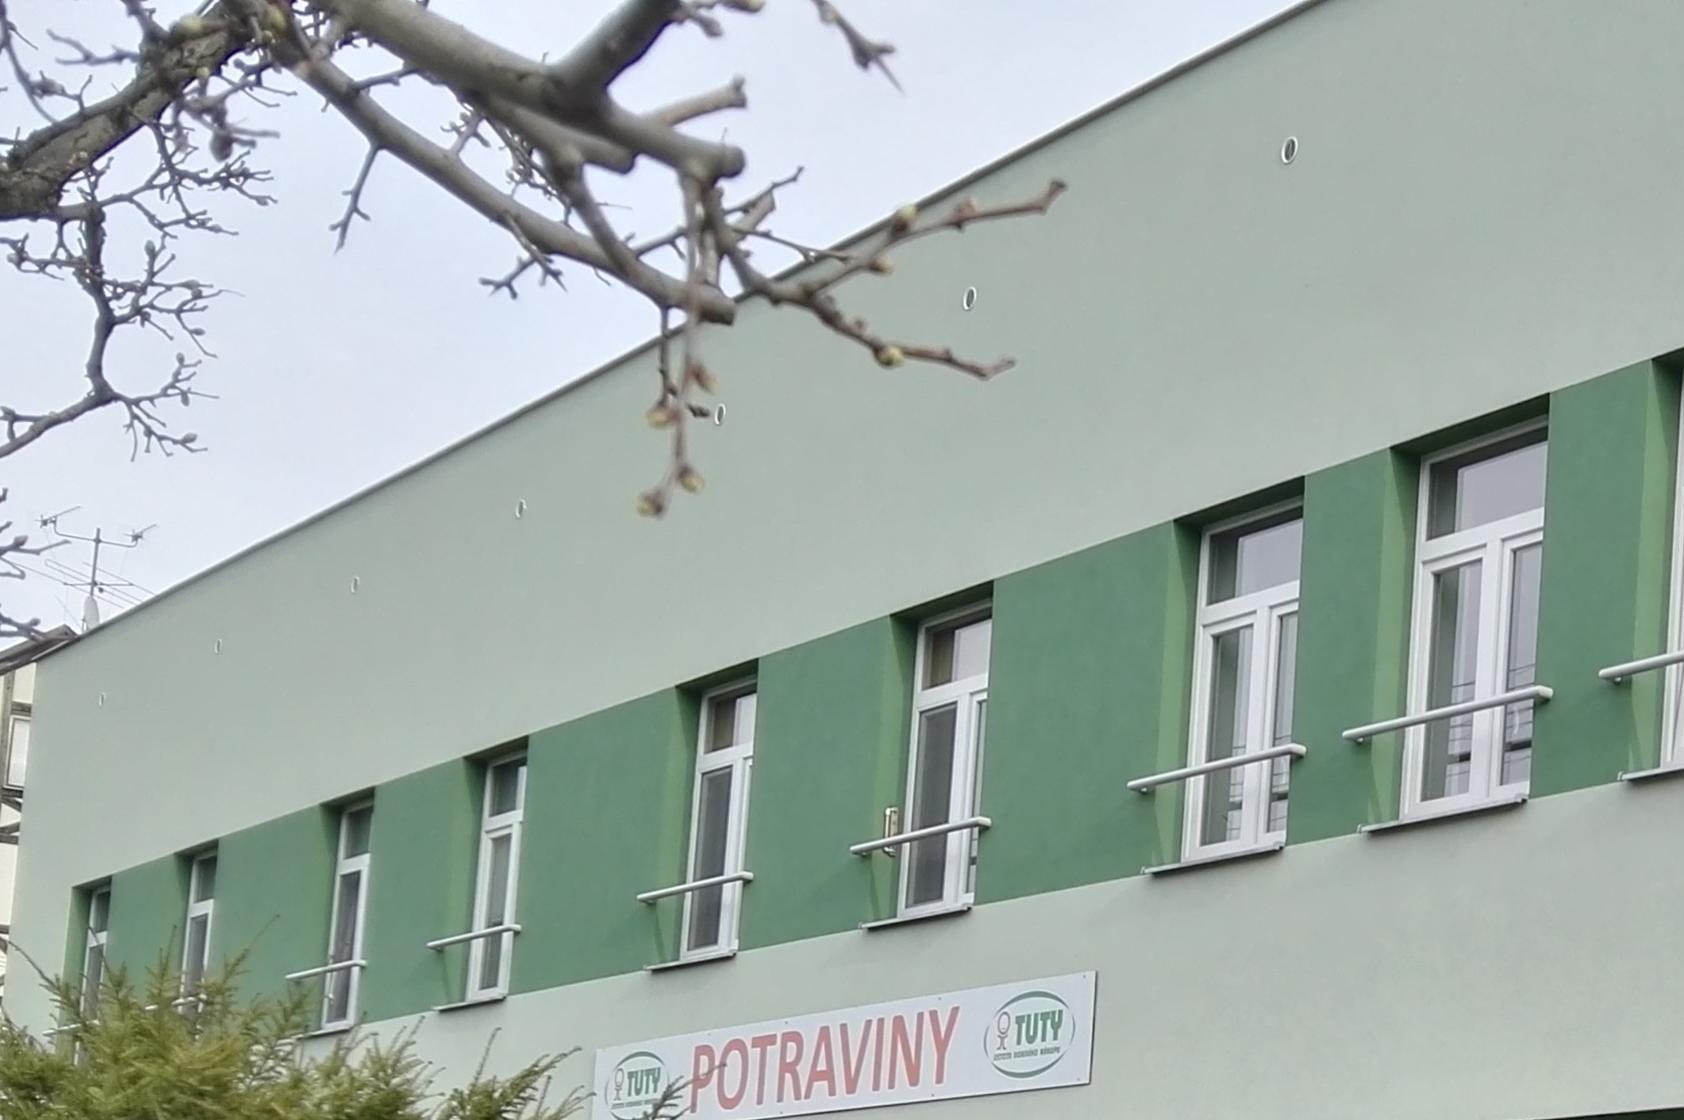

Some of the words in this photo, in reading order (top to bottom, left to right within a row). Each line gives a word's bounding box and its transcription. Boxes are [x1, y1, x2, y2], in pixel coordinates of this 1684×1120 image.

[1015, 1009, 1063, 1046] TUTY
[690, 1005, 961, 1114] POTRAVINY
[627, 1067, 662, 1097] TUTY
